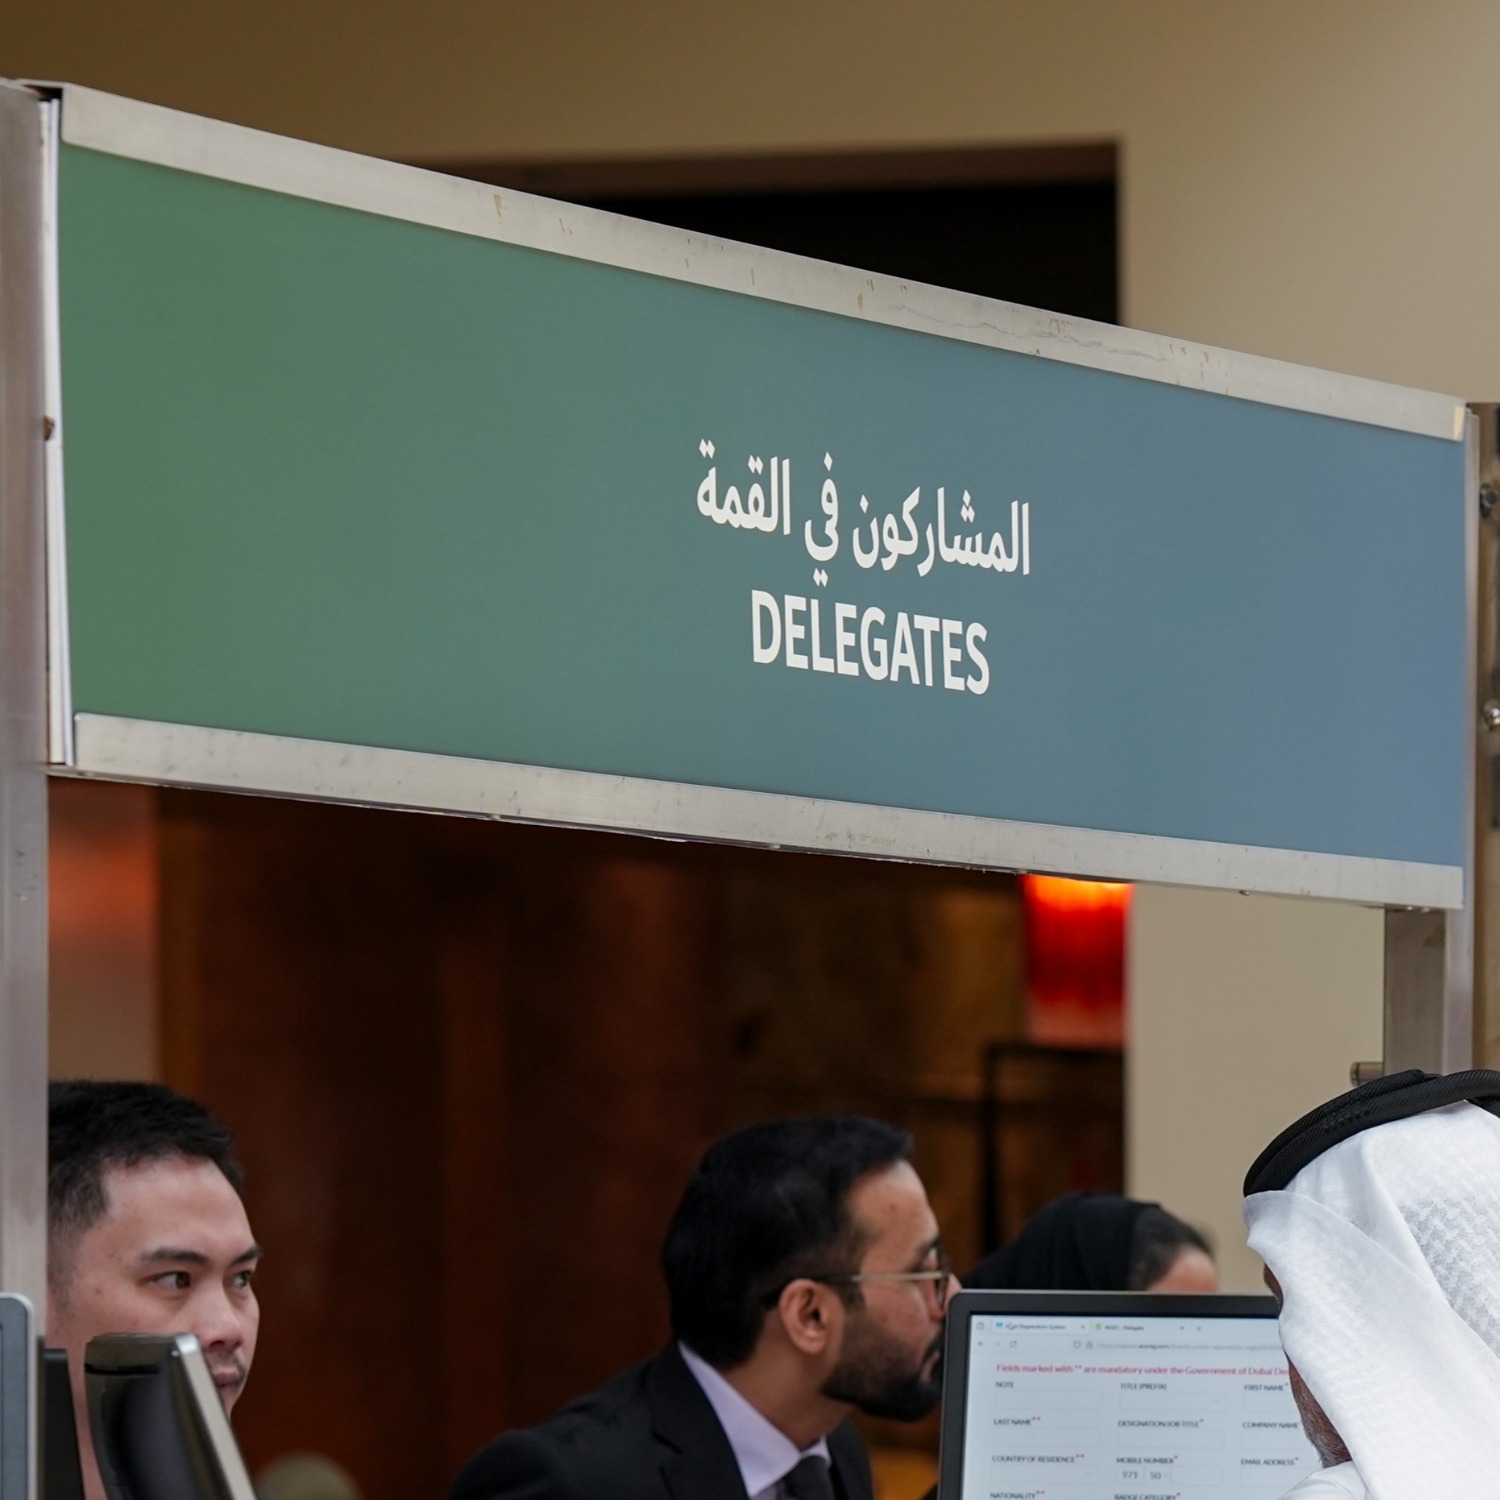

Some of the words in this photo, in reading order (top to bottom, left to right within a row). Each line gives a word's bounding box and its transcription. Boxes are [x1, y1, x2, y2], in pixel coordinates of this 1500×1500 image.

[697, 438, 791, 536] القمة
[804, 451, 839, 588] في
[852, 486, 1030, 577] المشاركون
[751, 589, 990, 695] DELEGATES
[996, 1364, 1021, 1373] Fields
[1021, 1365, 1054, 1373] marked
[1054, 1365, 1074, 1373] with
[1097, 1366, 1143, 1376] mandatory
[1143, 1366, 1169, 1375] under
[1169, 1366, 1184, 1375] the
[1184, 1366, 1237, 1375] Government
[1237, 1366, 1248, 1375] of
[1248, 1366, 1274, 1376] Dubai
[995, 1380, 1015, 1389] NOTE
[1120, 1382, 1138, 1390] TITLE
[1243, 1384, 1263, 1392] FIRST
[993, 1418, 1011, 1426] LAST
[1241, 1420, 1278, 1429] COMPANY
[991, 1455, 1026, 1463] COUNTRY
[1026, 1455, 1037, 1463] OF
[1240, 1458, 1262, 1466] EMAIL
[1121, 1470, 1139, 1480] 971
[1149, 1471, 1162, 1480] 50
[1114, 1493, 1138, 1500] BADGE
